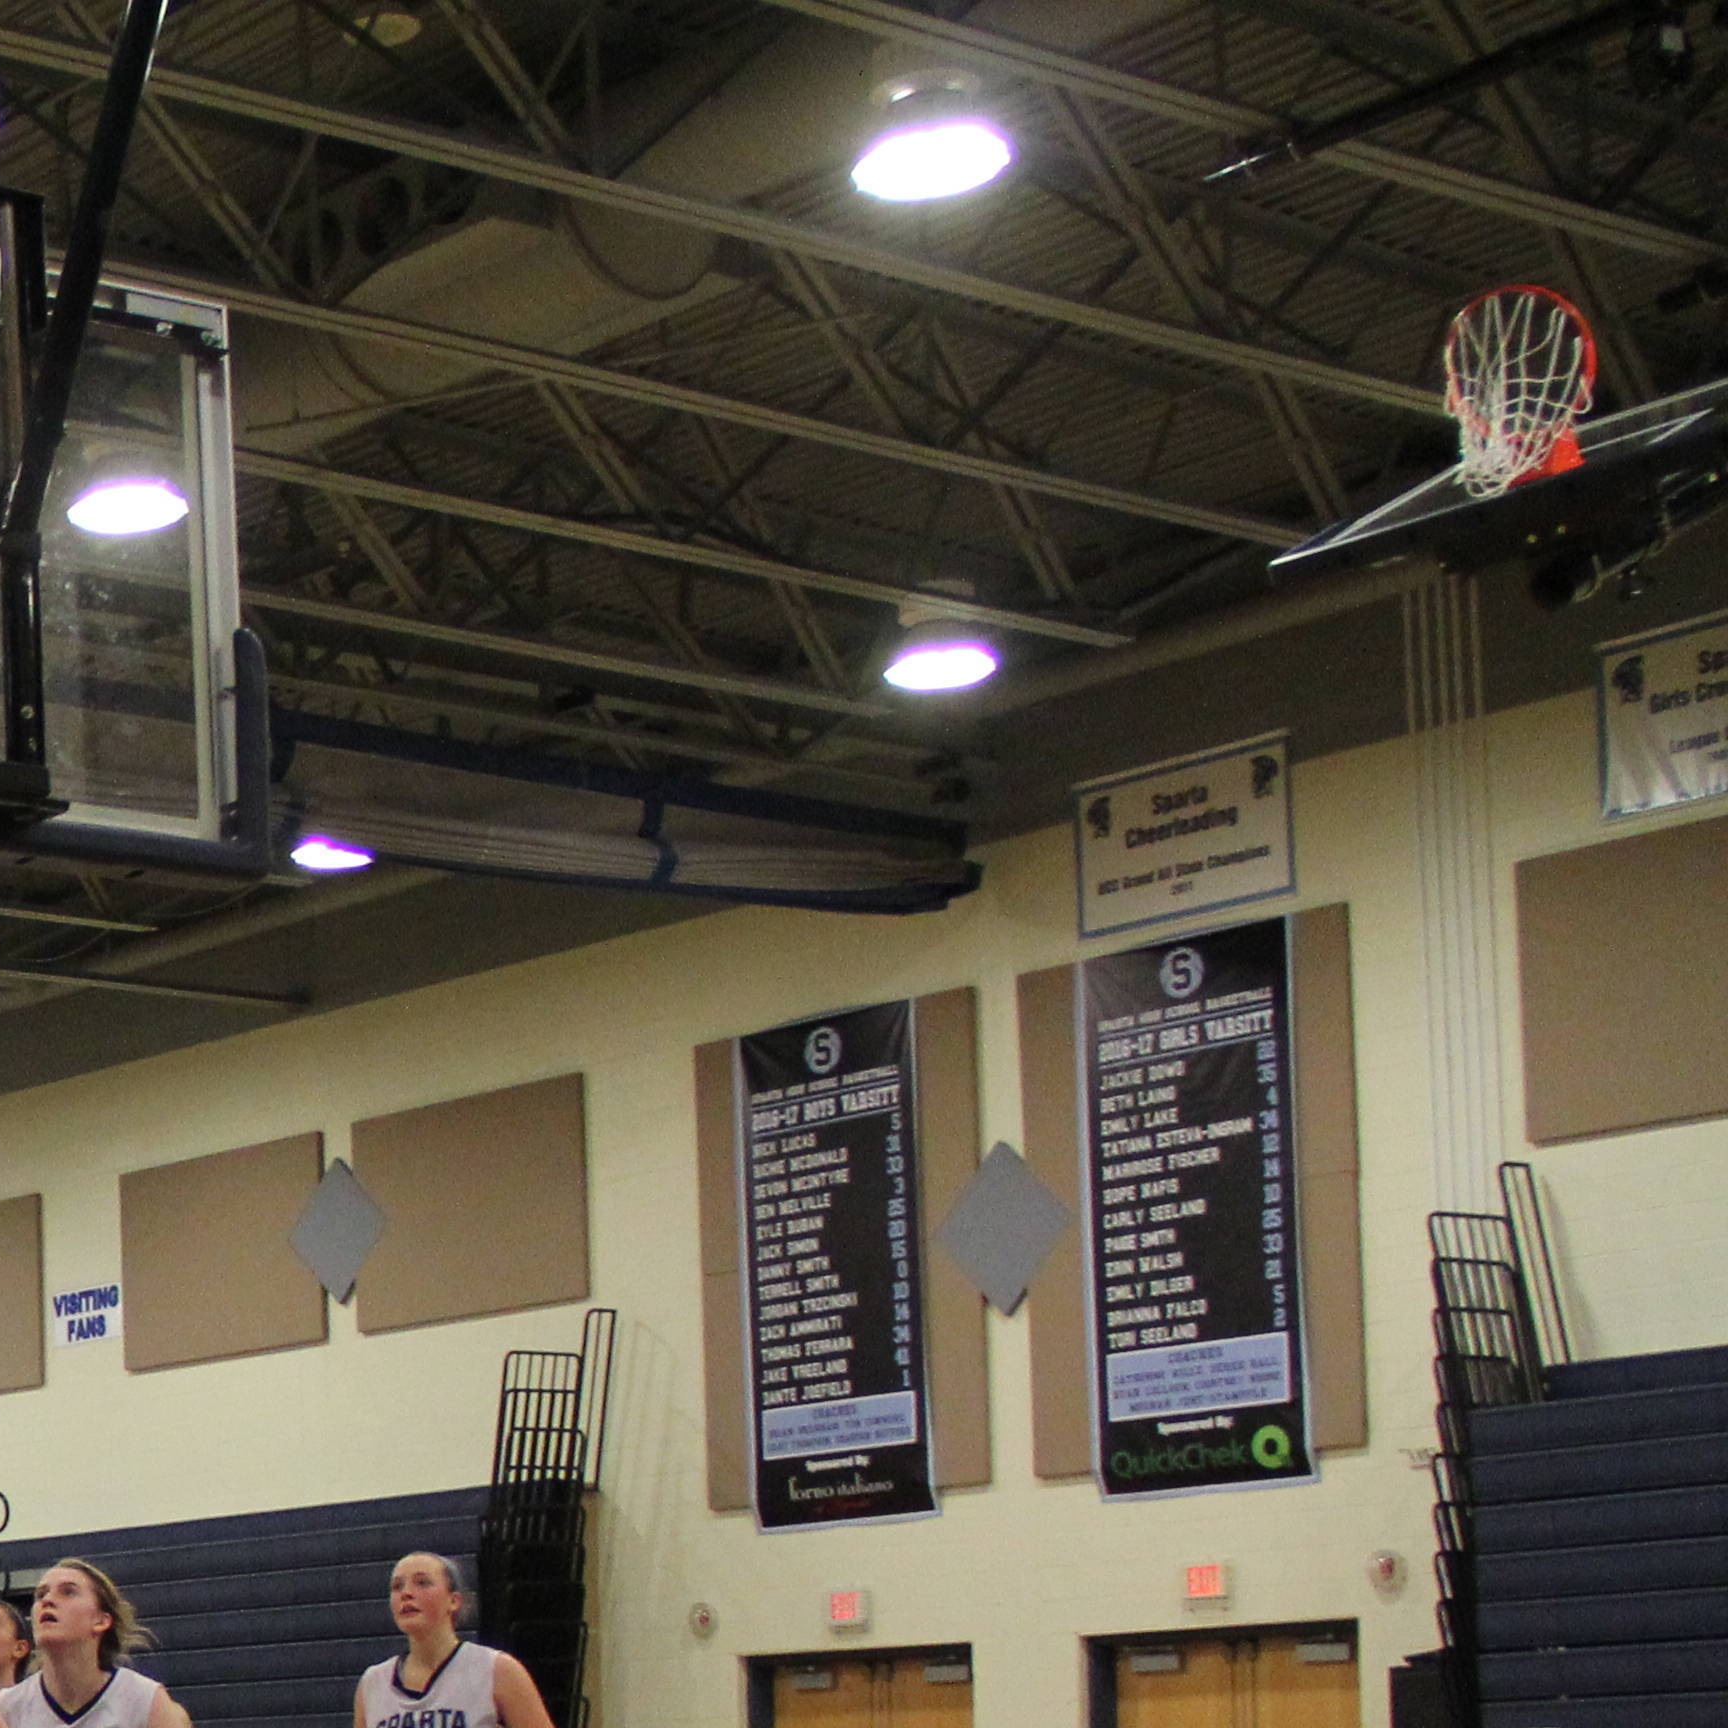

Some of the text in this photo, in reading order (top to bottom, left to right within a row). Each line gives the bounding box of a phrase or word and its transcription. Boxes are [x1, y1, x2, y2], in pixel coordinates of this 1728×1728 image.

[1152, 786, 1208, 815] Sparta
[1126, 806, 1238, 849] Cheerleading
[1171, 954, 1191, 991] S
[1158, 1024, 1199, 1050] GIRLS
[1204, 1009, 1274, 1041] VARSITY
[814, 1034, 832, 1067] S
[804, 1097, 836, 1122] BOYS
[841, 1084, 900, 1112] VARSITY
[1100, 1094, 1134, 1114] BETH
[1101, 1107, 1179, 1136] EMILY LAKE
[1167, 1146, 1221, 1170] FISCHER
[779, 1192, 831, 1216] MELVILLE
[1103, 1209, 1144, 1230] CARLY
[1140, 1229, 1177, 1248] SMITH
[796, 1256, 831, 1275] SMITH
[1139, 1252, 1184, 1273] WALSH
[806, 1274, 840, 1292] SMITH
[1106, 1283, 1144, 1302] EMILY
[53, 1285, 119, 1317] VISITING
[68, 1314, 106, 1342] FANS
[761, 1343, 801, 1363] THOMAS
